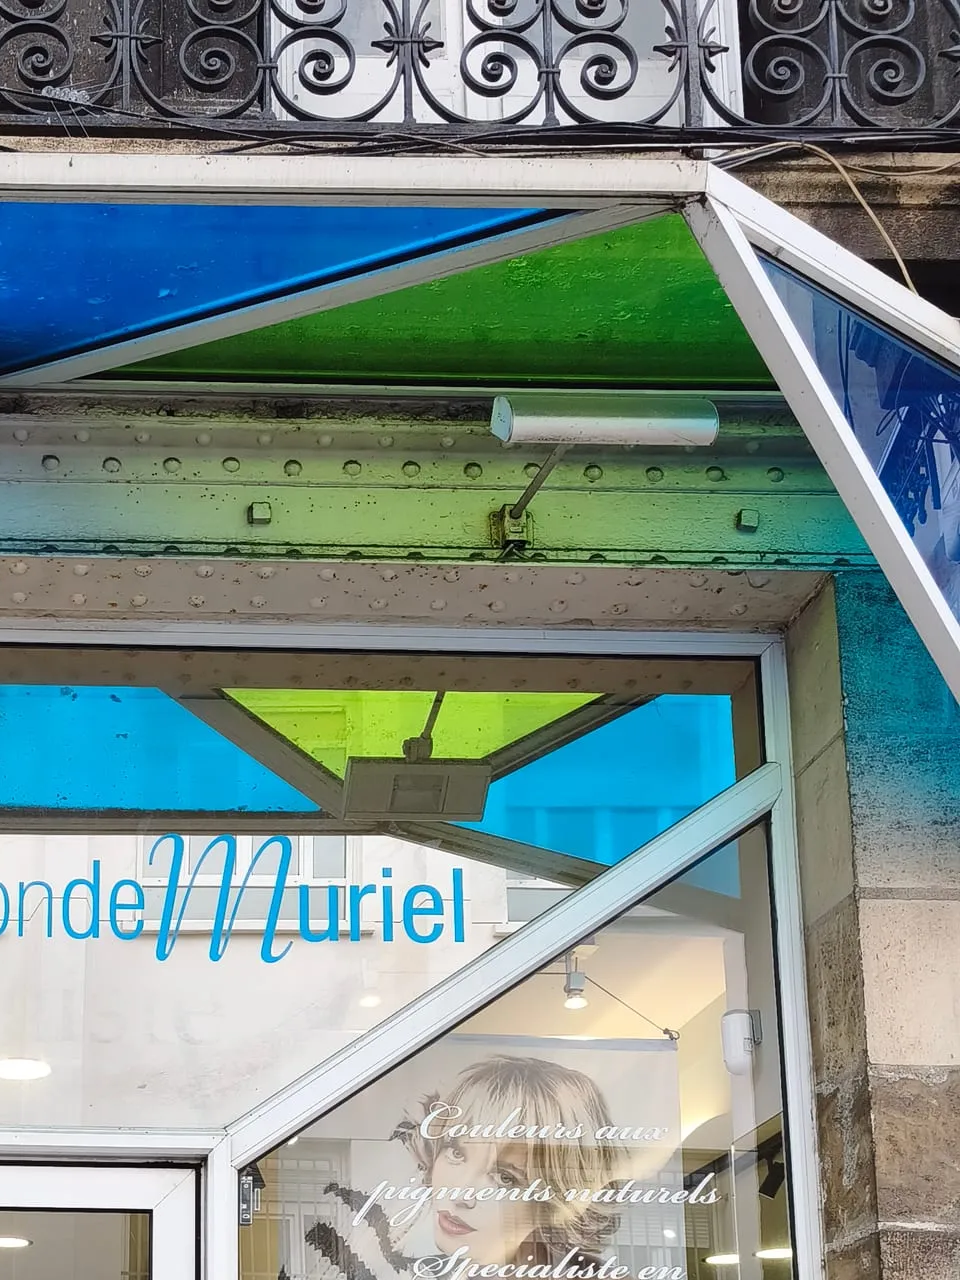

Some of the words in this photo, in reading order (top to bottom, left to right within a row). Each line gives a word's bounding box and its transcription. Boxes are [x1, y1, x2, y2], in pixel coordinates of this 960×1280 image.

[420, 1102, 588, 1141] Couleurs
[593, 1123, 670, 1141] aux
[352, 1177, 554, 1227] pigments
[563, 1173, 722, 1206] naturels
[641, 1266, 687, 1280] en
